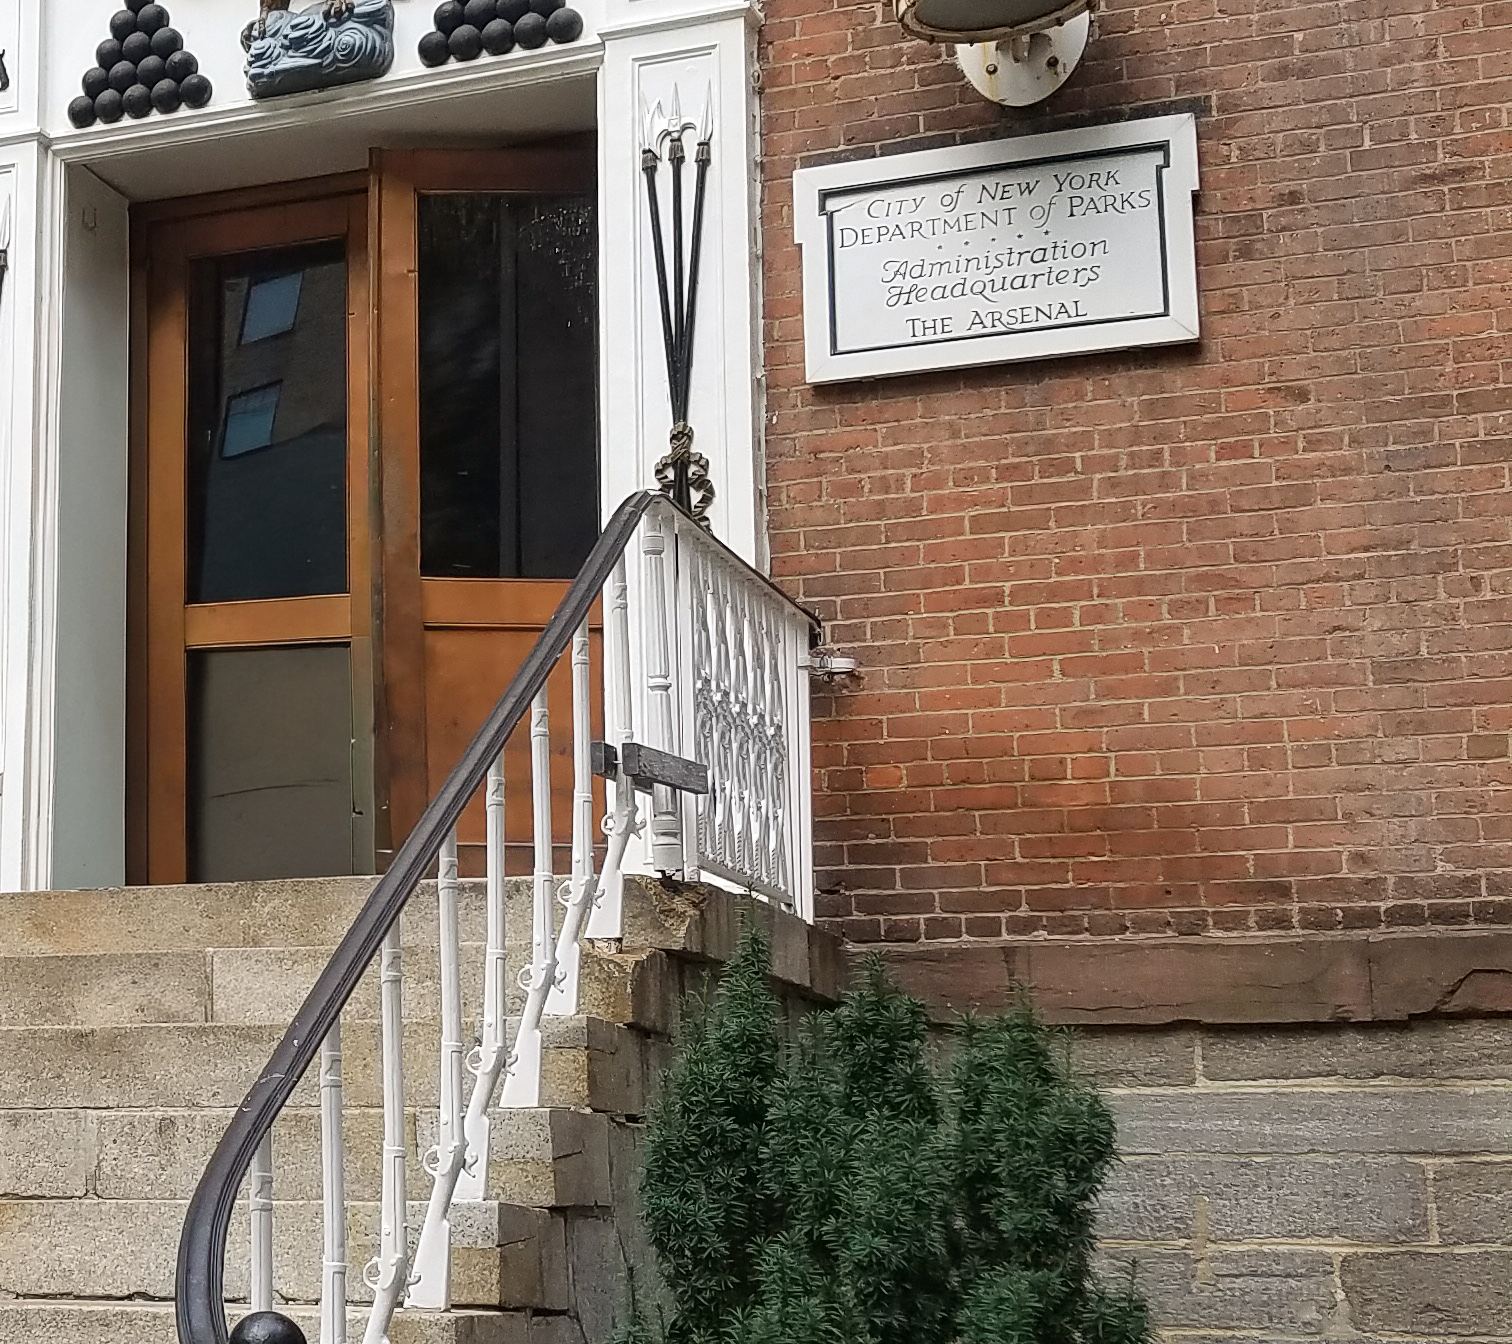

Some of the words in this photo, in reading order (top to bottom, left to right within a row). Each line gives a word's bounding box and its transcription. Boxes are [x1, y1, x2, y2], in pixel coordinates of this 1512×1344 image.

[867, 196, 926, 219] CITY
[940, 183, 967, 213] of
[977, 179, 1041, 204] NEW
[1052, 169, 1121, 193] YORK
[839, 207, 1018, 249] DEPARTMENT
[1029, 194, 1059, 229] of
[1067, 189, 1152, 218] PARKS
[881, 239, 1110, 283] Administration
[886, 264, 1101, 308] Headquarters
[905, 316, 953, 338] THE
[966, 299, 1088, 332] ARSENAL
